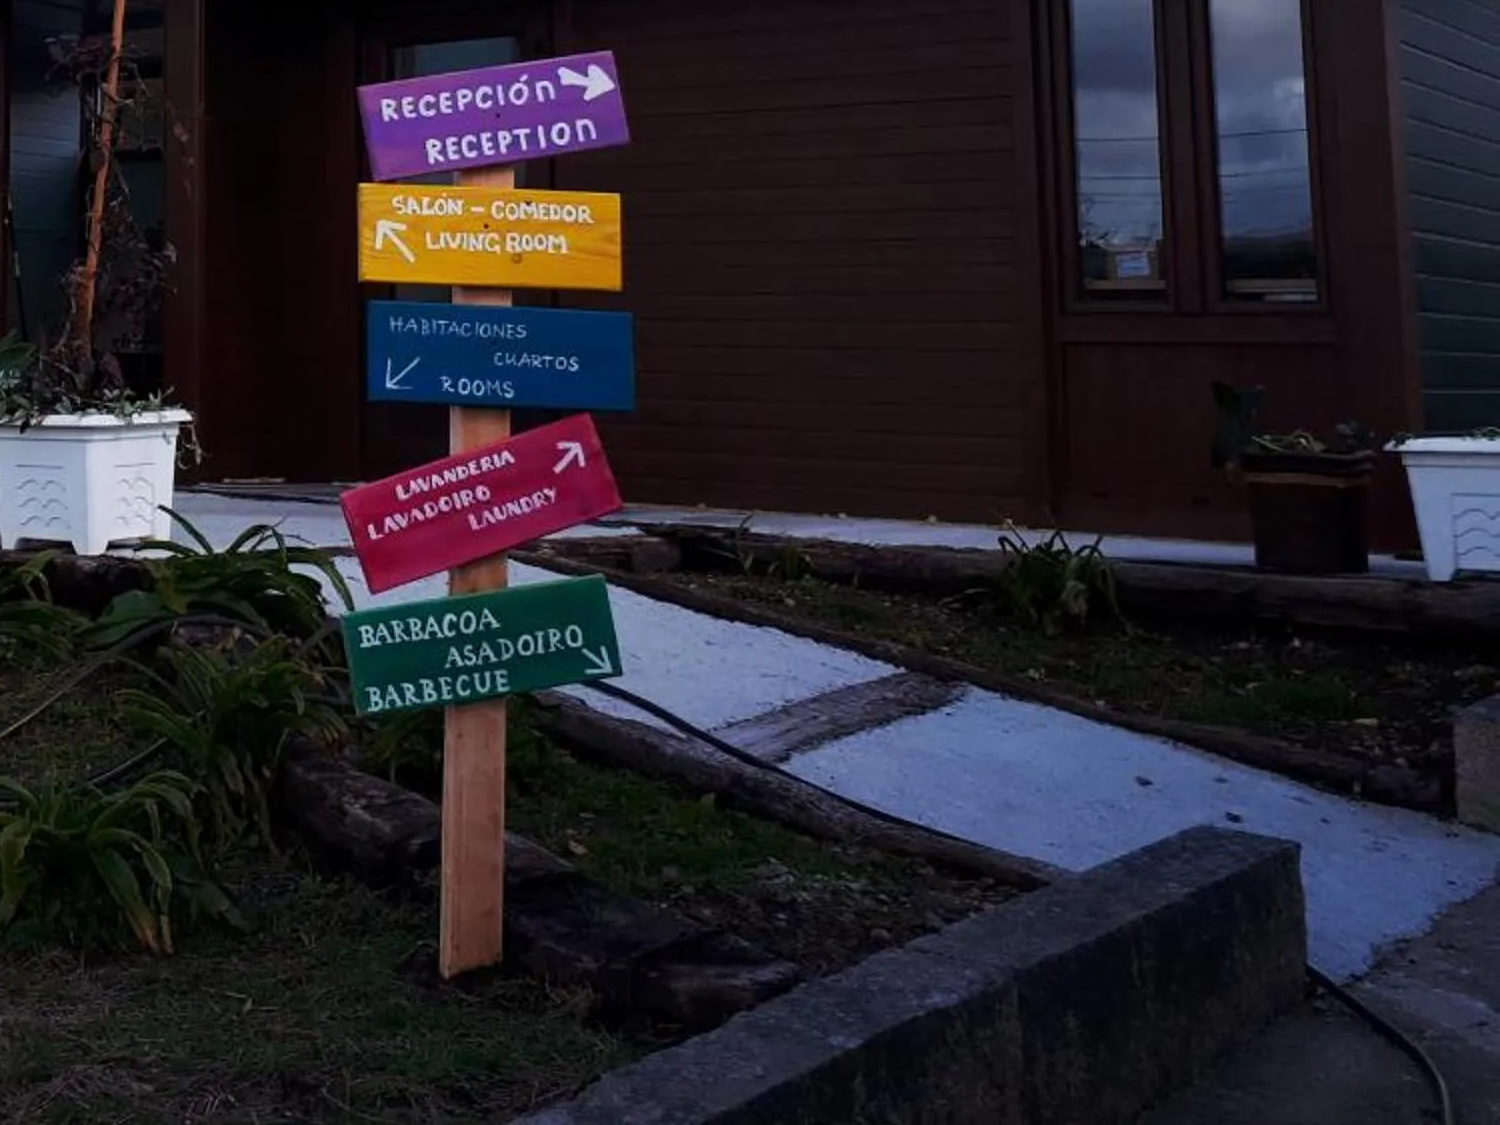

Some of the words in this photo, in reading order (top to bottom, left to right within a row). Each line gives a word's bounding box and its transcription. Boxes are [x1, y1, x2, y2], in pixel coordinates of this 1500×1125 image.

[391, 193, 465, 216] SALÓN
[491, 200, 594, 224] COMEDOR
[425, 228, 501, 254] LIVING
[505, 231, 570, 254] ROOM
[389, 316, 529, 339] HABITACIONES
[494, 351, 581, 372] CUARTOS
[440, 375, 516, 399] ROOMS
[395, 450, 516, 500] LAVANDERIA
[367, 485, 491, 540] LAVADOIRO
[468, 486, 557, 531] LAUNDRY
[357, 607, 501, 649] BARBACOA
[444, 624, 584, 668] ASADOIRO
[365, 669, 511, 713] BARBECUE
